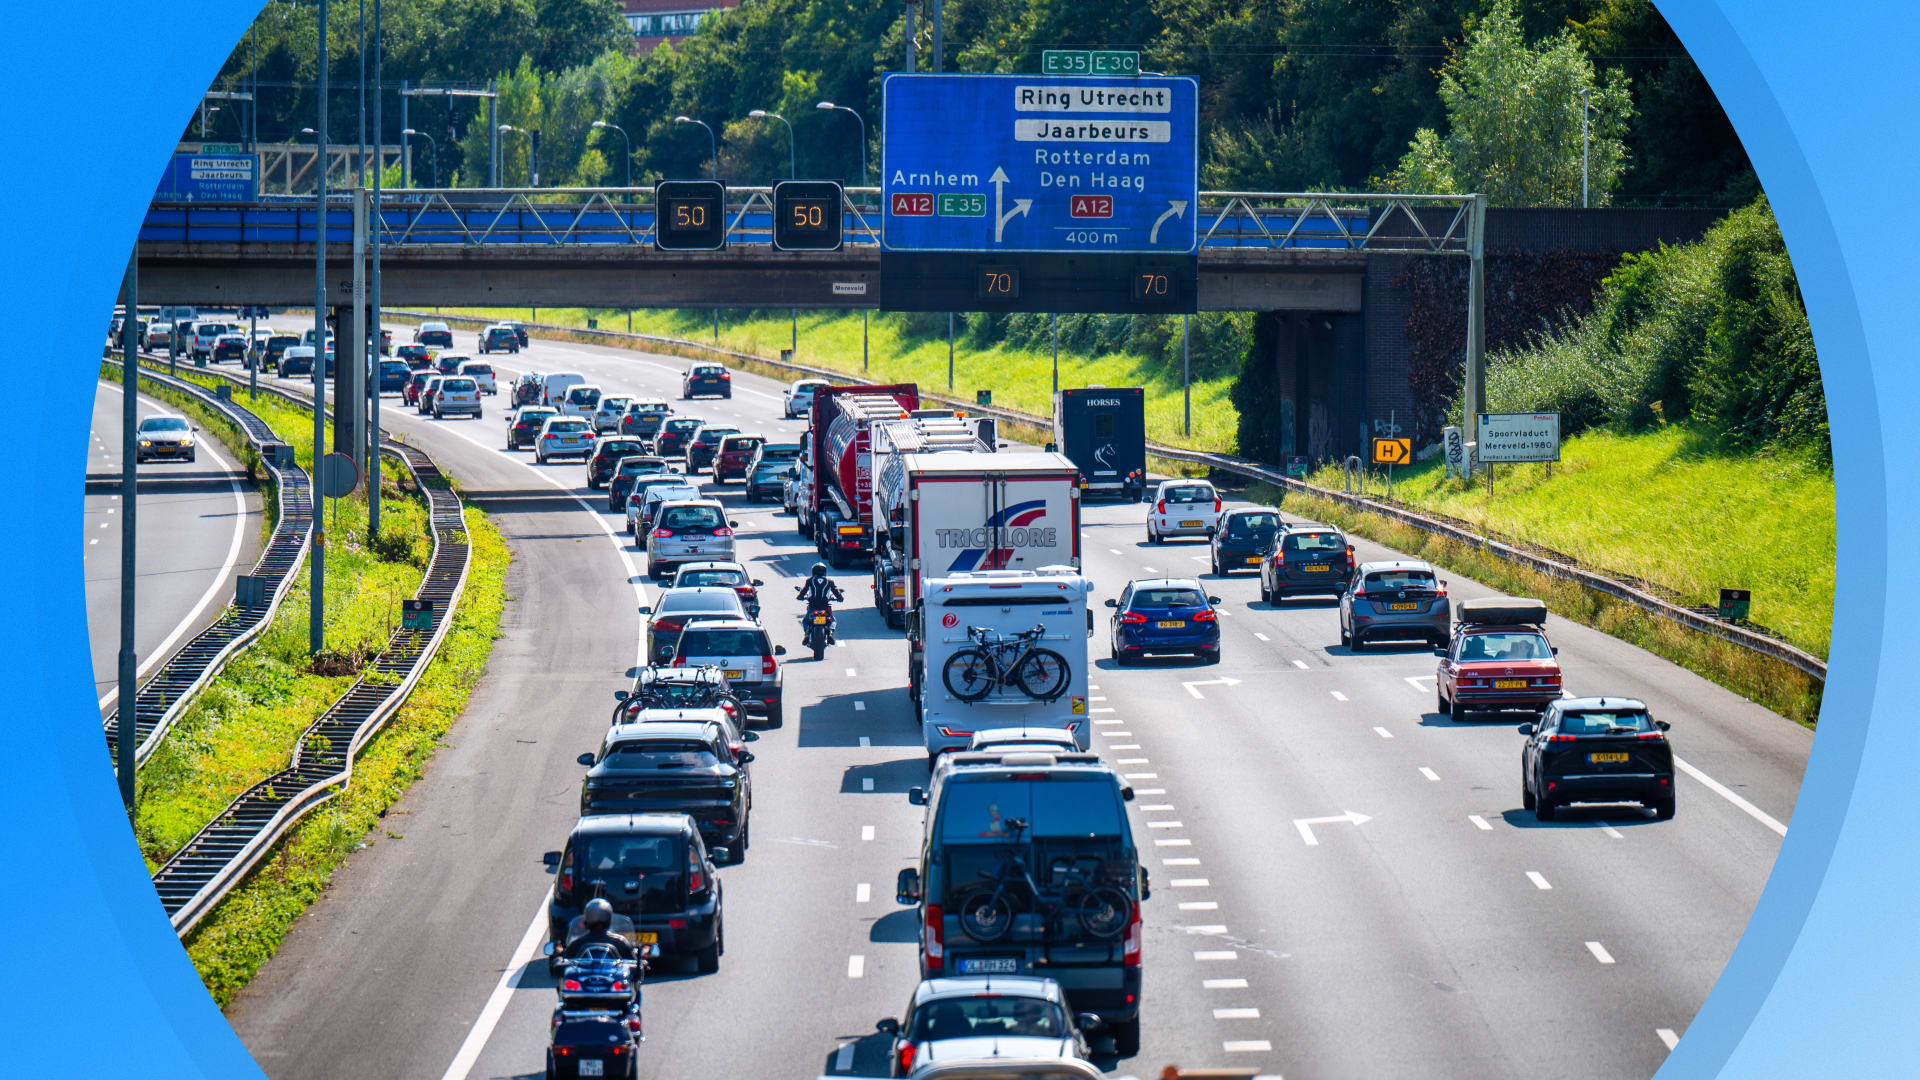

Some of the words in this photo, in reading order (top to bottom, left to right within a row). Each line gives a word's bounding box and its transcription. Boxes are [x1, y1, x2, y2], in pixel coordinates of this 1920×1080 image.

[1022, 89, 1070, 109] Ring
[1081, 90, 1164, 107] Utrecht
[1037, 122, 1150, 140] Jaarbeurs
[194, 160, 214, 168] Ring
[1035, 149, 1150, 166] Rotterdam
[892, 170, 978, 187] Arnhem
[1040, 172, 1080, 188] Den
[1091, 172, 1145, 192] Haag
[896, 197, 931, 212] A12
[1075, 199, 1110, 214] A12
[676, 205, 705, 226] 50
[793, 205, 822, 226] 50
[1065, 232, 1099, 245] 400
[1103, 234, 1118, 245] m
[985, 273, 1011, 293] 70
[1142, 274, 1168, 295] 70
[1087, 399, 1121, 407] HORSES
[1488, 430, 1549, 438] Spoorviaduct
[1383, 445, 1394, 457] H
[935, 527, 1057, 548] TRICOLORE
